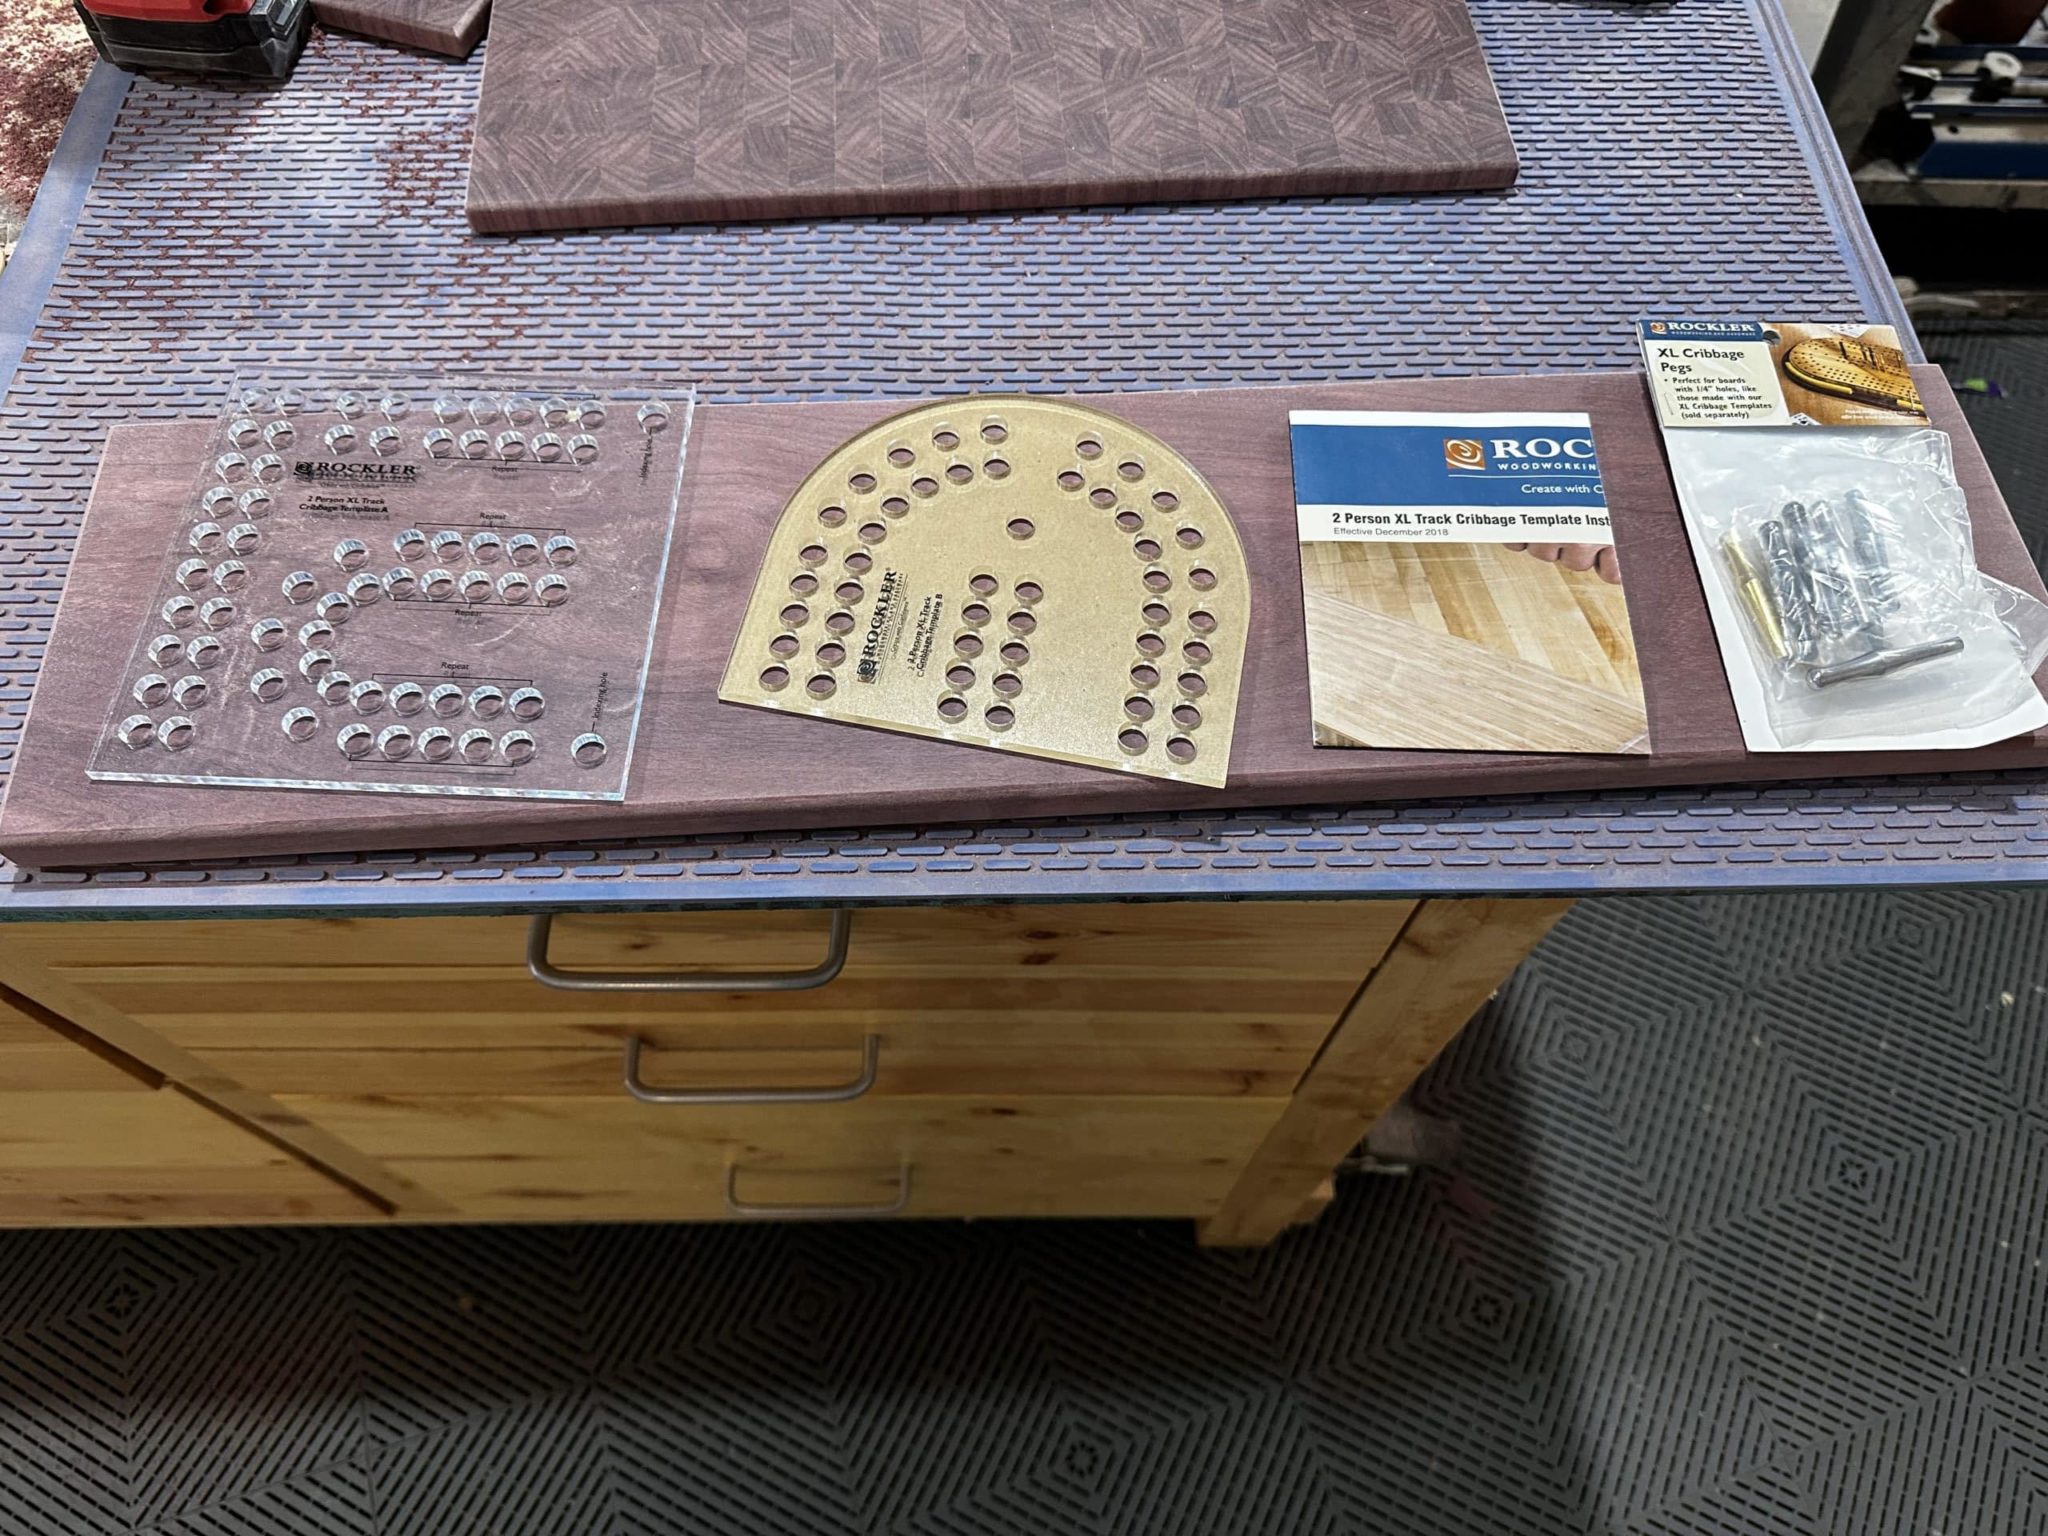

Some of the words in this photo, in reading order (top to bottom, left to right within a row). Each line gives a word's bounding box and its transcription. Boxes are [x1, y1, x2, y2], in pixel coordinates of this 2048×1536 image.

[1667, 321, 1756, 332] ROCKLER
[1657, 348, 1680, 358] XL
[1682, 348, 1745, 361] Cribbage
[1660, 362, 1692, 374] Pegs
[1692, 403, 1728, 411] Cribbage
[1730, 403, 1772, 411] Templates
[1704, 412, 1749, 420] separately)
[1490, 438, 1594, 459] ROC
[316, 461, 416, 475] ROCKLER
[1498, 462, 1596, 471] WOODWORKIN
[1521, 483, 1562, 494] Create
[1565, 484, 1590, 493] with
[299, 503, 338, 512] Cribbage
[1332, 512, 1341, 523] 2
[1345, 513, 1391, 524] Person
[1395, 513, 1411, 524] XL
[1415, 514, 1452, 524] Track
[1456, 514, 1516, 527] Cribbage
[1520, 514, 1582, 527] Template
[1586, 515, 1610, 526] Inst
[1333, 527, 1373, 535] Effective
[1375, 528, 1422, 536] December
[1425, 528, 1449, 536] 2018
[920, 597, 931, 617] Track
[863, 571, 897, 657] ROCKLER
